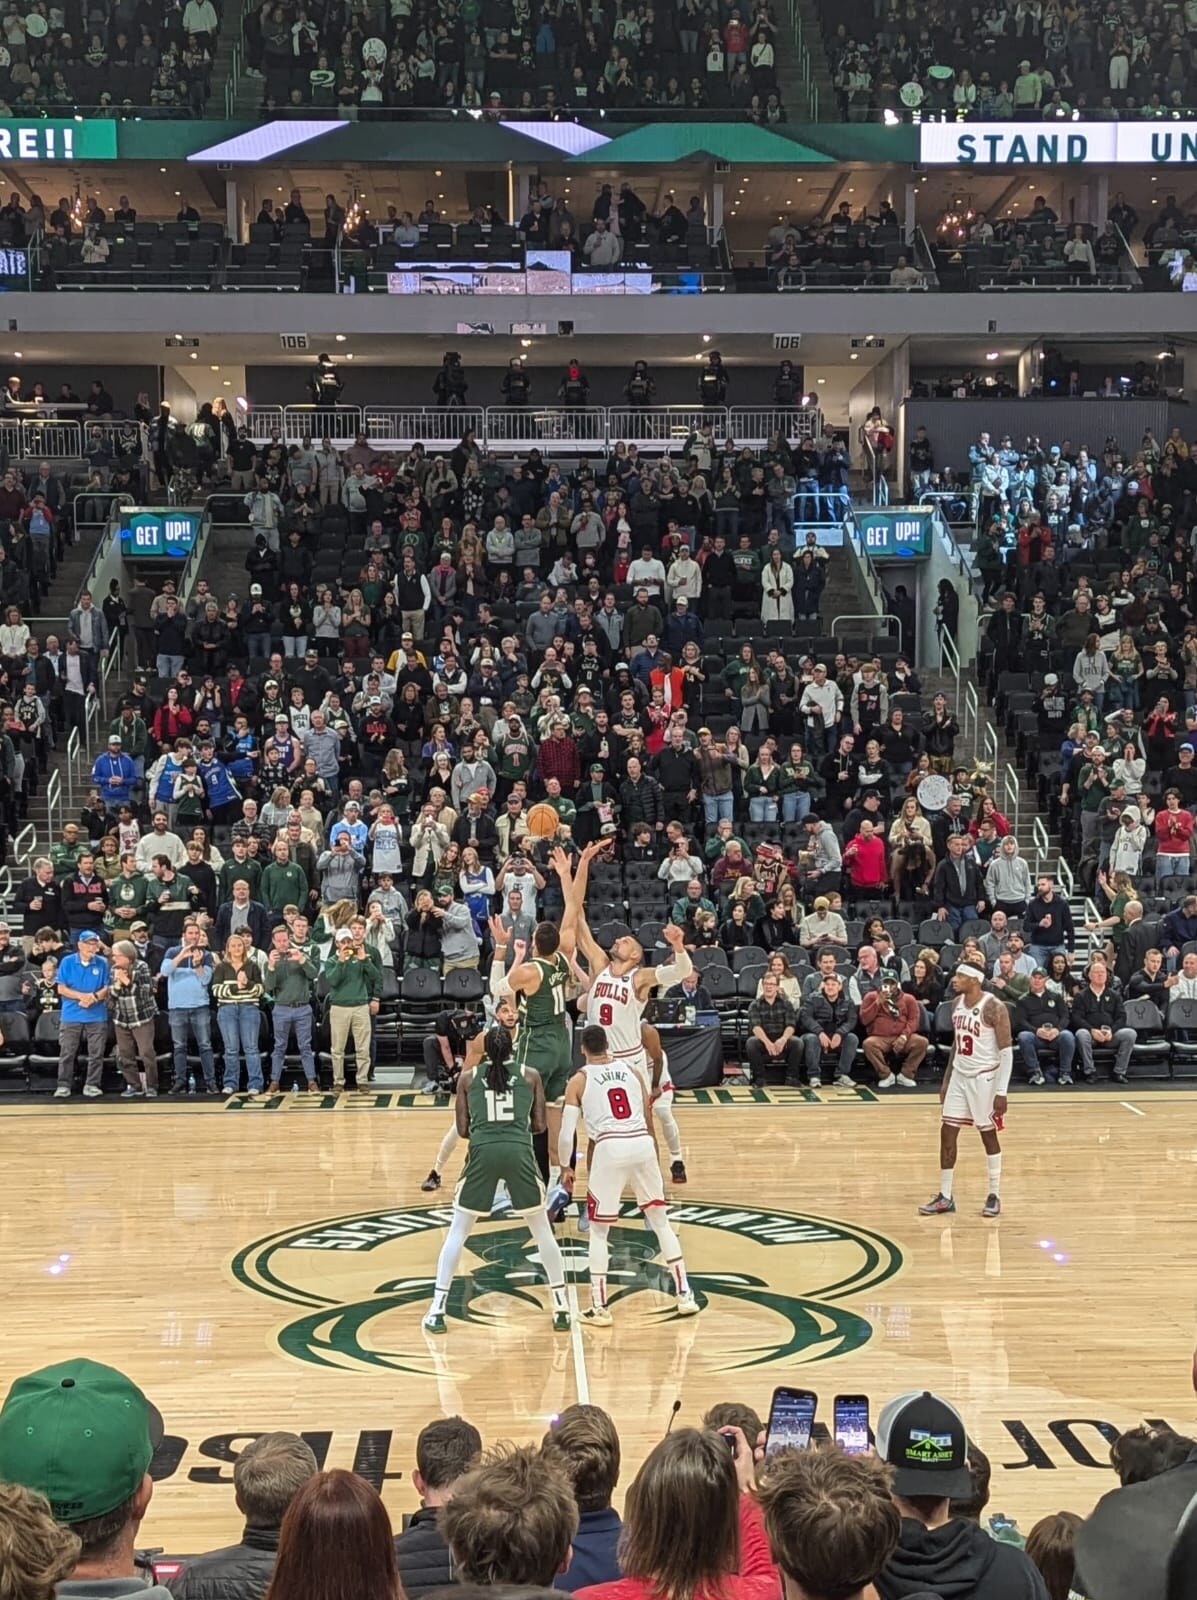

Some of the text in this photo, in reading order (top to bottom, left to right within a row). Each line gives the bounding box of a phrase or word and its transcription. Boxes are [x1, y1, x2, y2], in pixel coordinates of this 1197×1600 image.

[956, 134, 1088, 163] STAND
[281, 335, 307, 349] 106
[775, 336, 800, 349] 106
[136, 520, 191, 546] GET UP!!
[866, 521, 920, 546] GET UP!!
[551, 983, 566, 1016] 11
[593, 982, 629, 1006] BULLS
[599, 1003, 614, 1026] 9
[956, 1034, 974, 1057] 13
[593, 1071, 628, 1086] LAVINE
[224, 1087, 880, 1111] DEER FEAR
[484, 1089, 515, 1122] 12
[607, 1087, 632, 1120] 8
